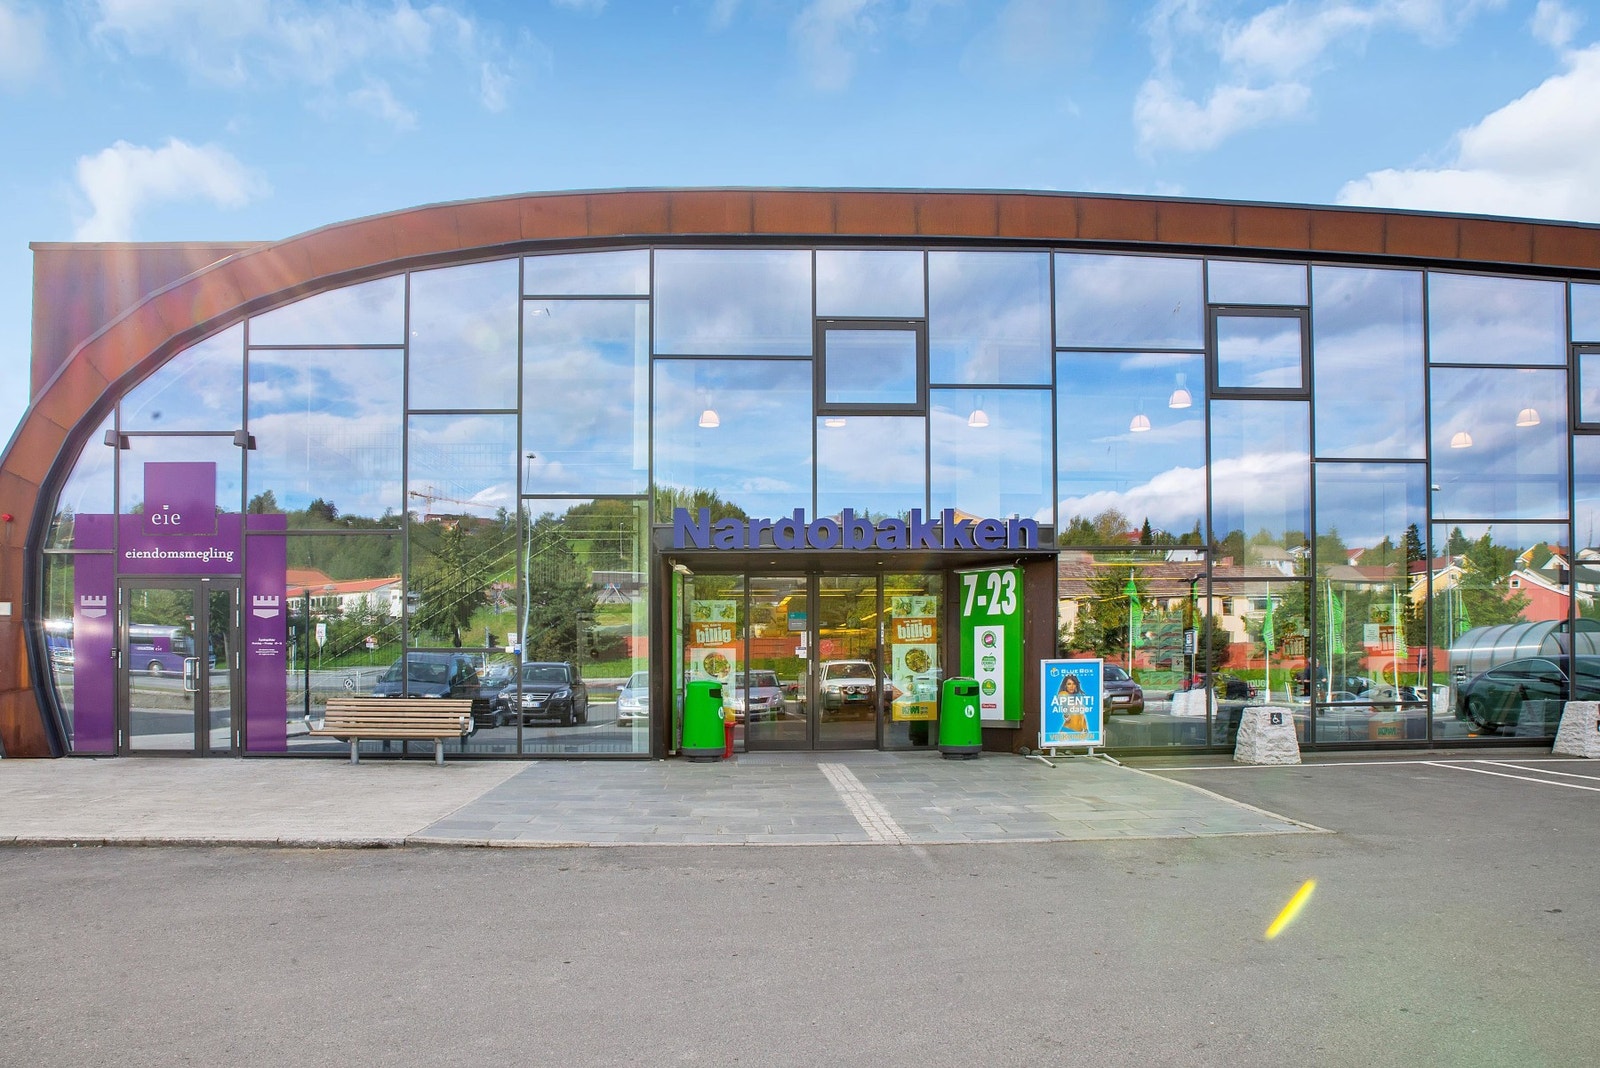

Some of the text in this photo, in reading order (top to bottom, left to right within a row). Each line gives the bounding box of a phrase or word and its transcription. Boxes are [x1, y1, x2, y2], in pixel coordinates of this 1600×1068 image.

[151, 504, 181, 525] eie
[673, 507, 1038, 550] Nardobakken
[125, 547, 234, 562] eiendomsmegling
[963, 571, 1017, 616] 7-23
[695, 627, 732, 643] billig
[897, 622, 932, 639] billig
[1069, 706, 1093, 714] dager
